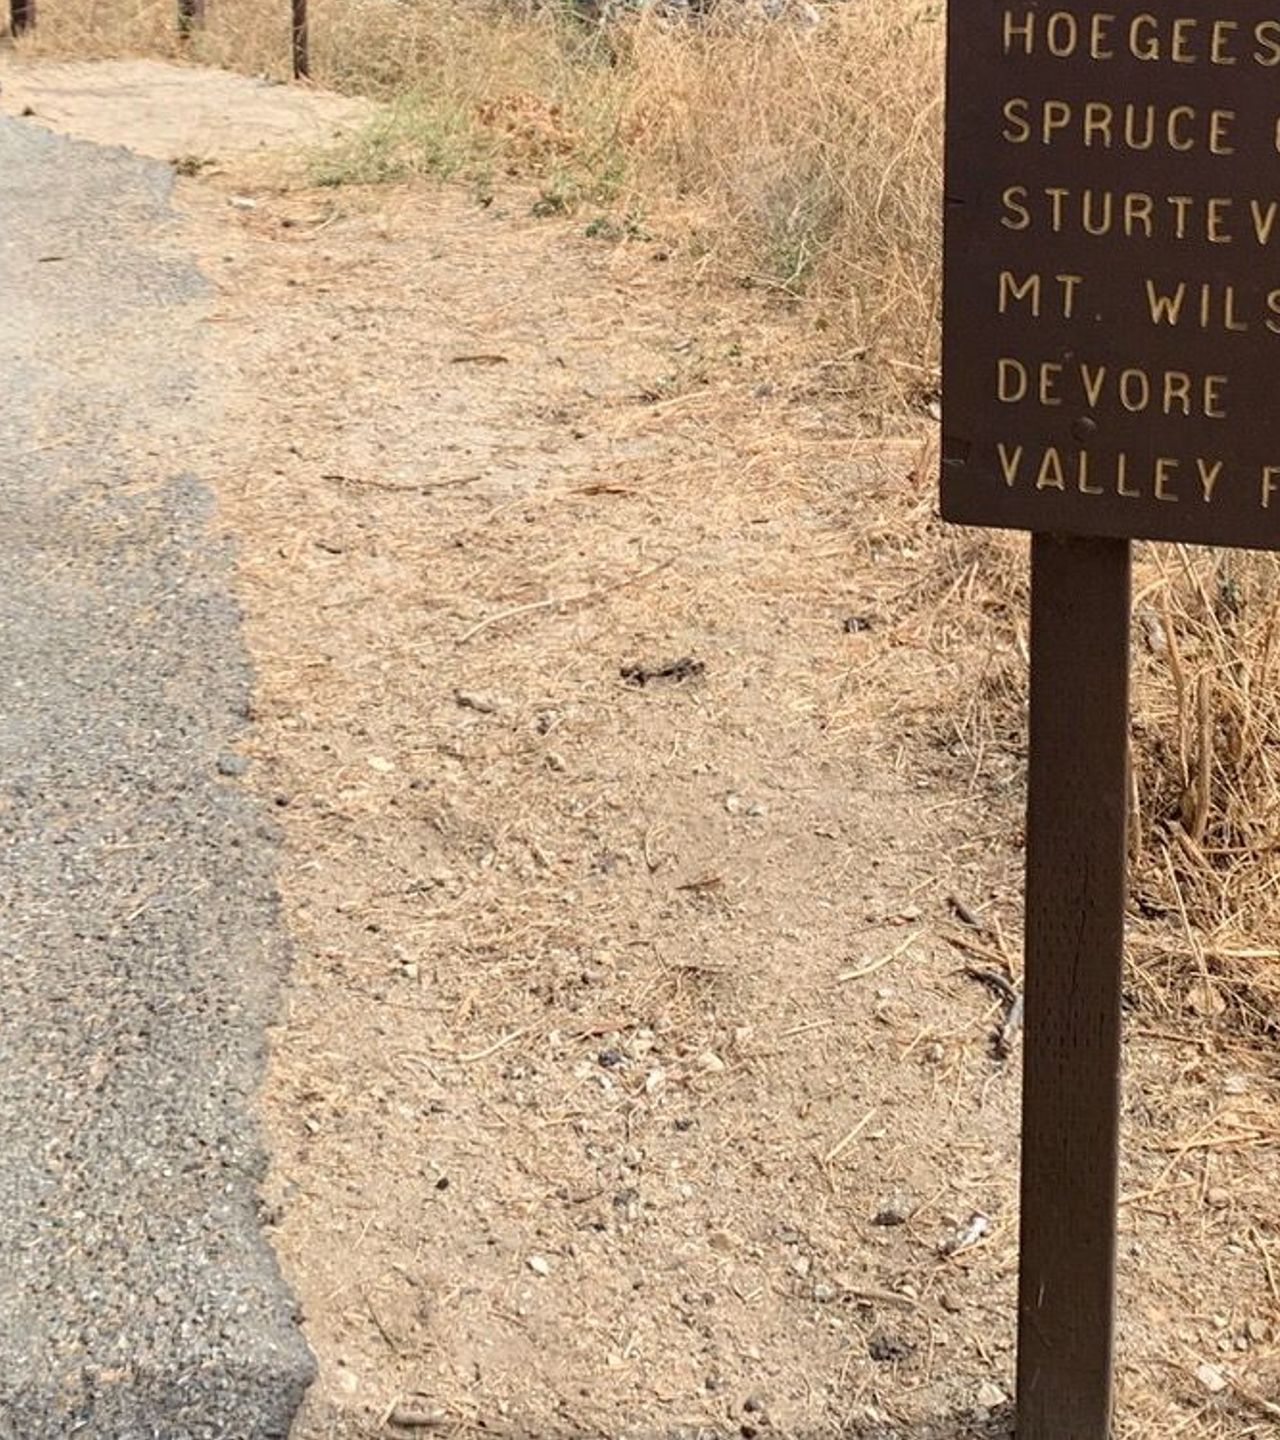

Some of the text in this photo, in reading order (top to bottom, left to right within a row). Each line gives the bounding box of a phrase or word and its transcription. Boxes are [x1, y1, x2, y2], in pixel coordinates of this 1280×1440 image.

[1002, 98, 1235, 155] SPRUCE
[998, 270, 1102, 319] MT.
[997, 358, 1228, 417] DEVORE
[997, 442, 1223, 503] VALLEY
